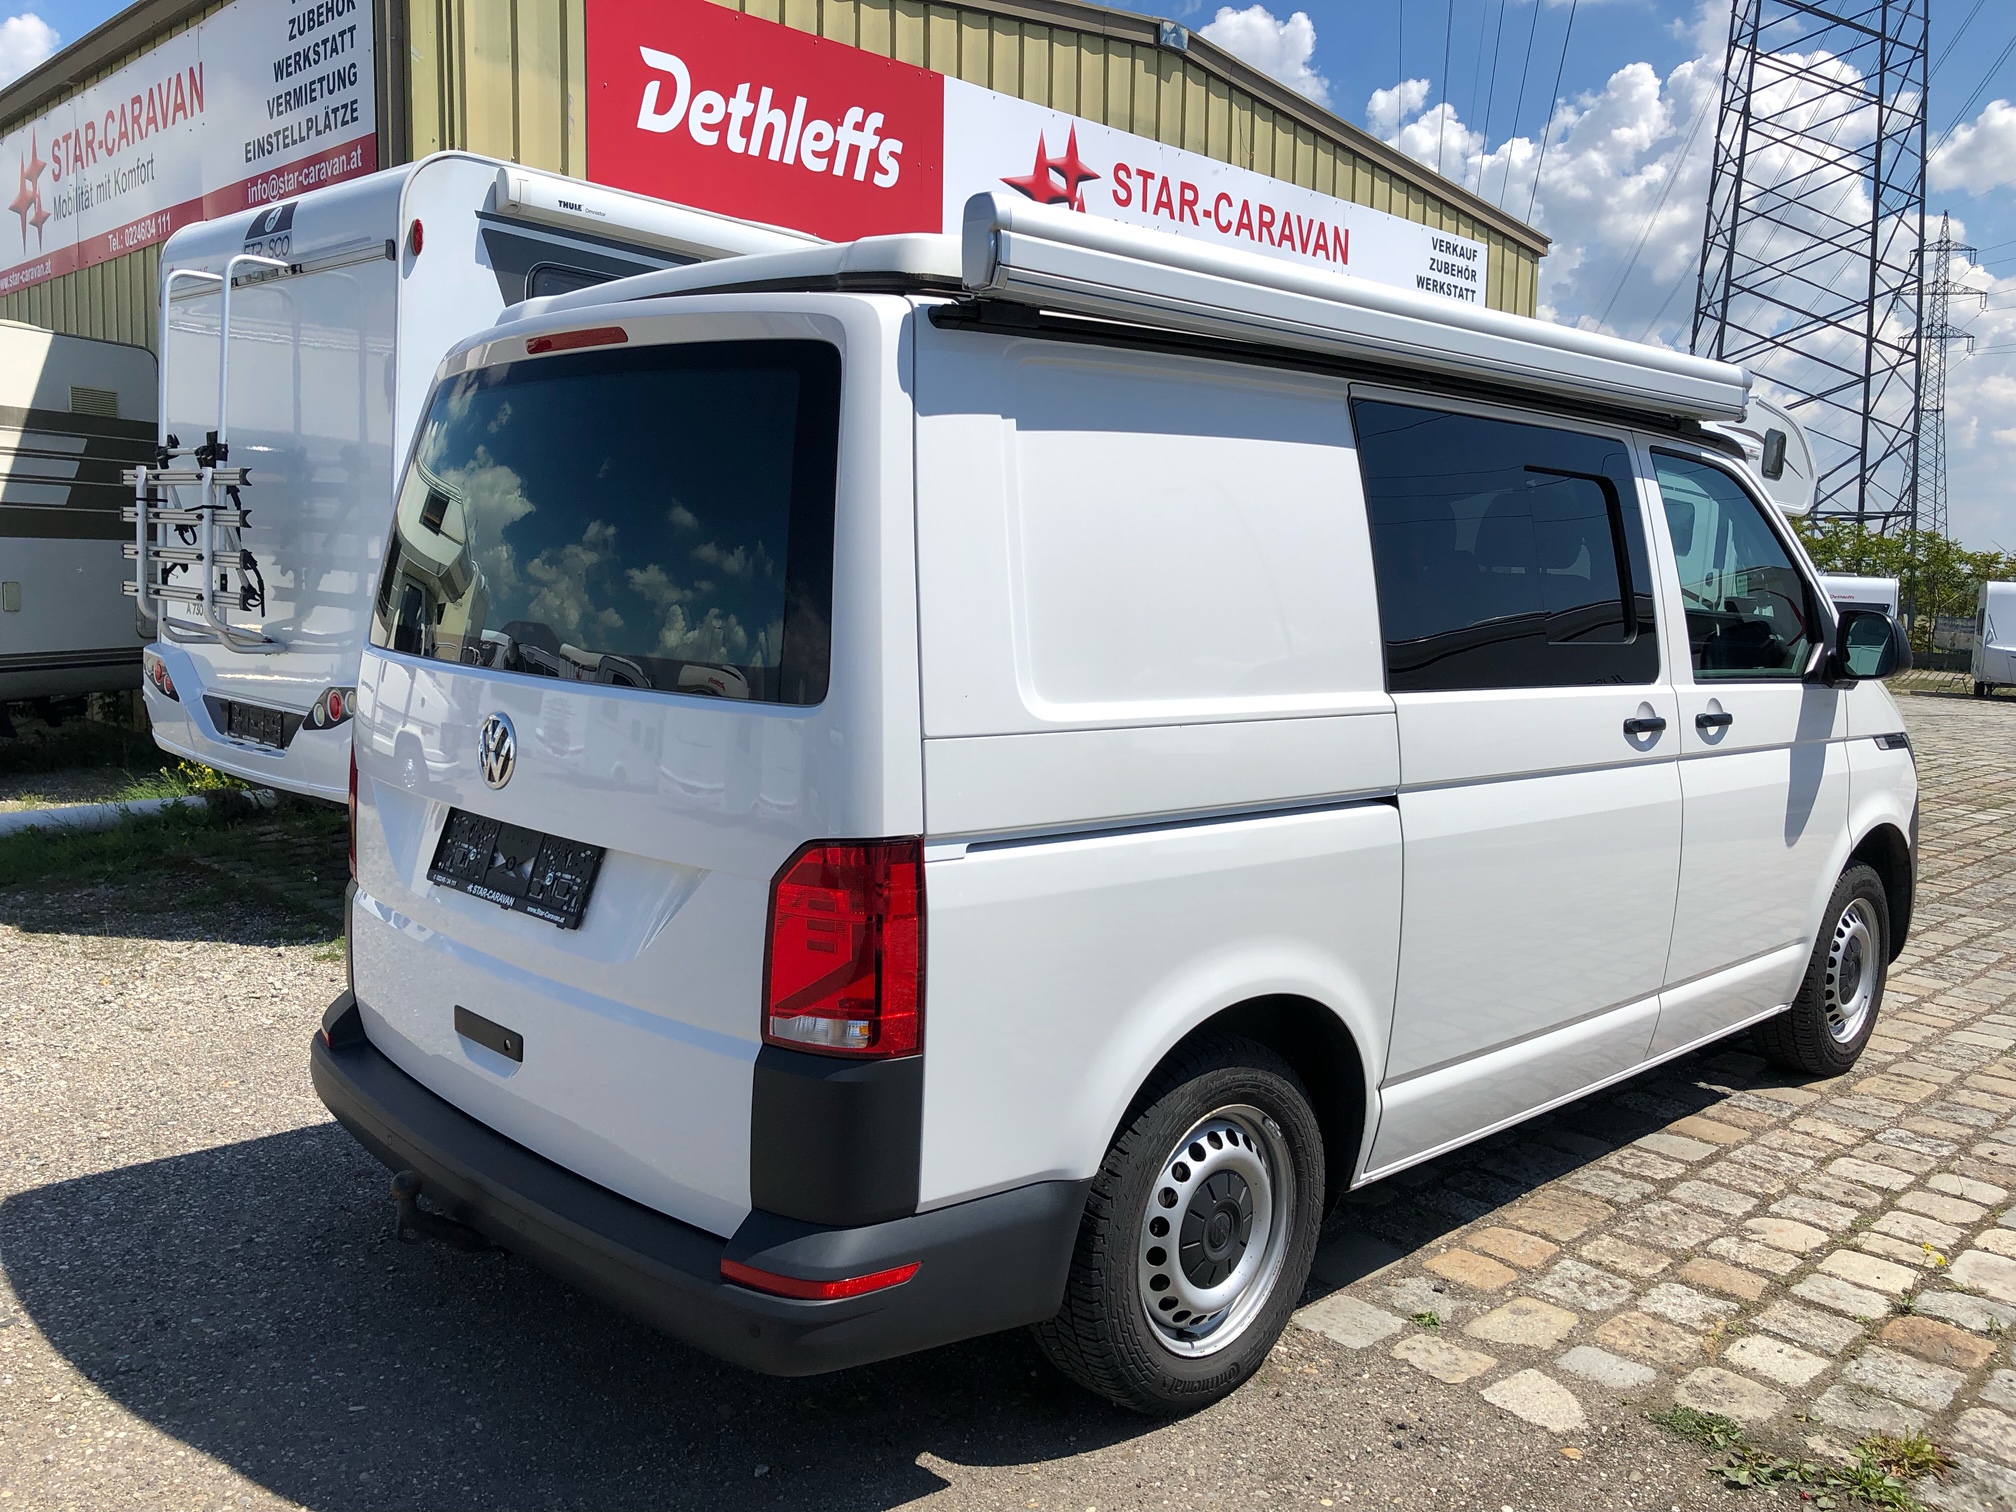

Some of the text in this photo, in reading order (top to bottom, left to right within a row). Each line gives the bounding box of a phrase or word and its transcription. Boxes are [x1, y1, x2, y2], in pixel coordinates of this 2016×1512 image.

[273, 24, 356, 83] WERKSTATT
[266, 62, 358, 120] VERMIETUNG
[638, 46, 903, 188] Dethleffs
[51, 61, 204, 183] STAR-CARAVAN
[245, 99, 358, 163] EINSTELLPLÄTZE
[53, 152, 155, 222] Mobilität mit Komfort
[248, 144, 362, 204] info@star-caravan.at
[108, 233, 124, 253] Tel.:
[157, 212, 171, 233] 111
[558, 199, 582, 212] THULE
[1111, 161, 1350, 266] STAR-CARAVAN
[1428, 256, 1477, 283] ZUBEHÖR
[1432, 237, 1478, 263] VERKAUF
[1416, 274, 1477, 303] WERKSTATT
[472, 884, 516, 907] STAR-CARAVAN
